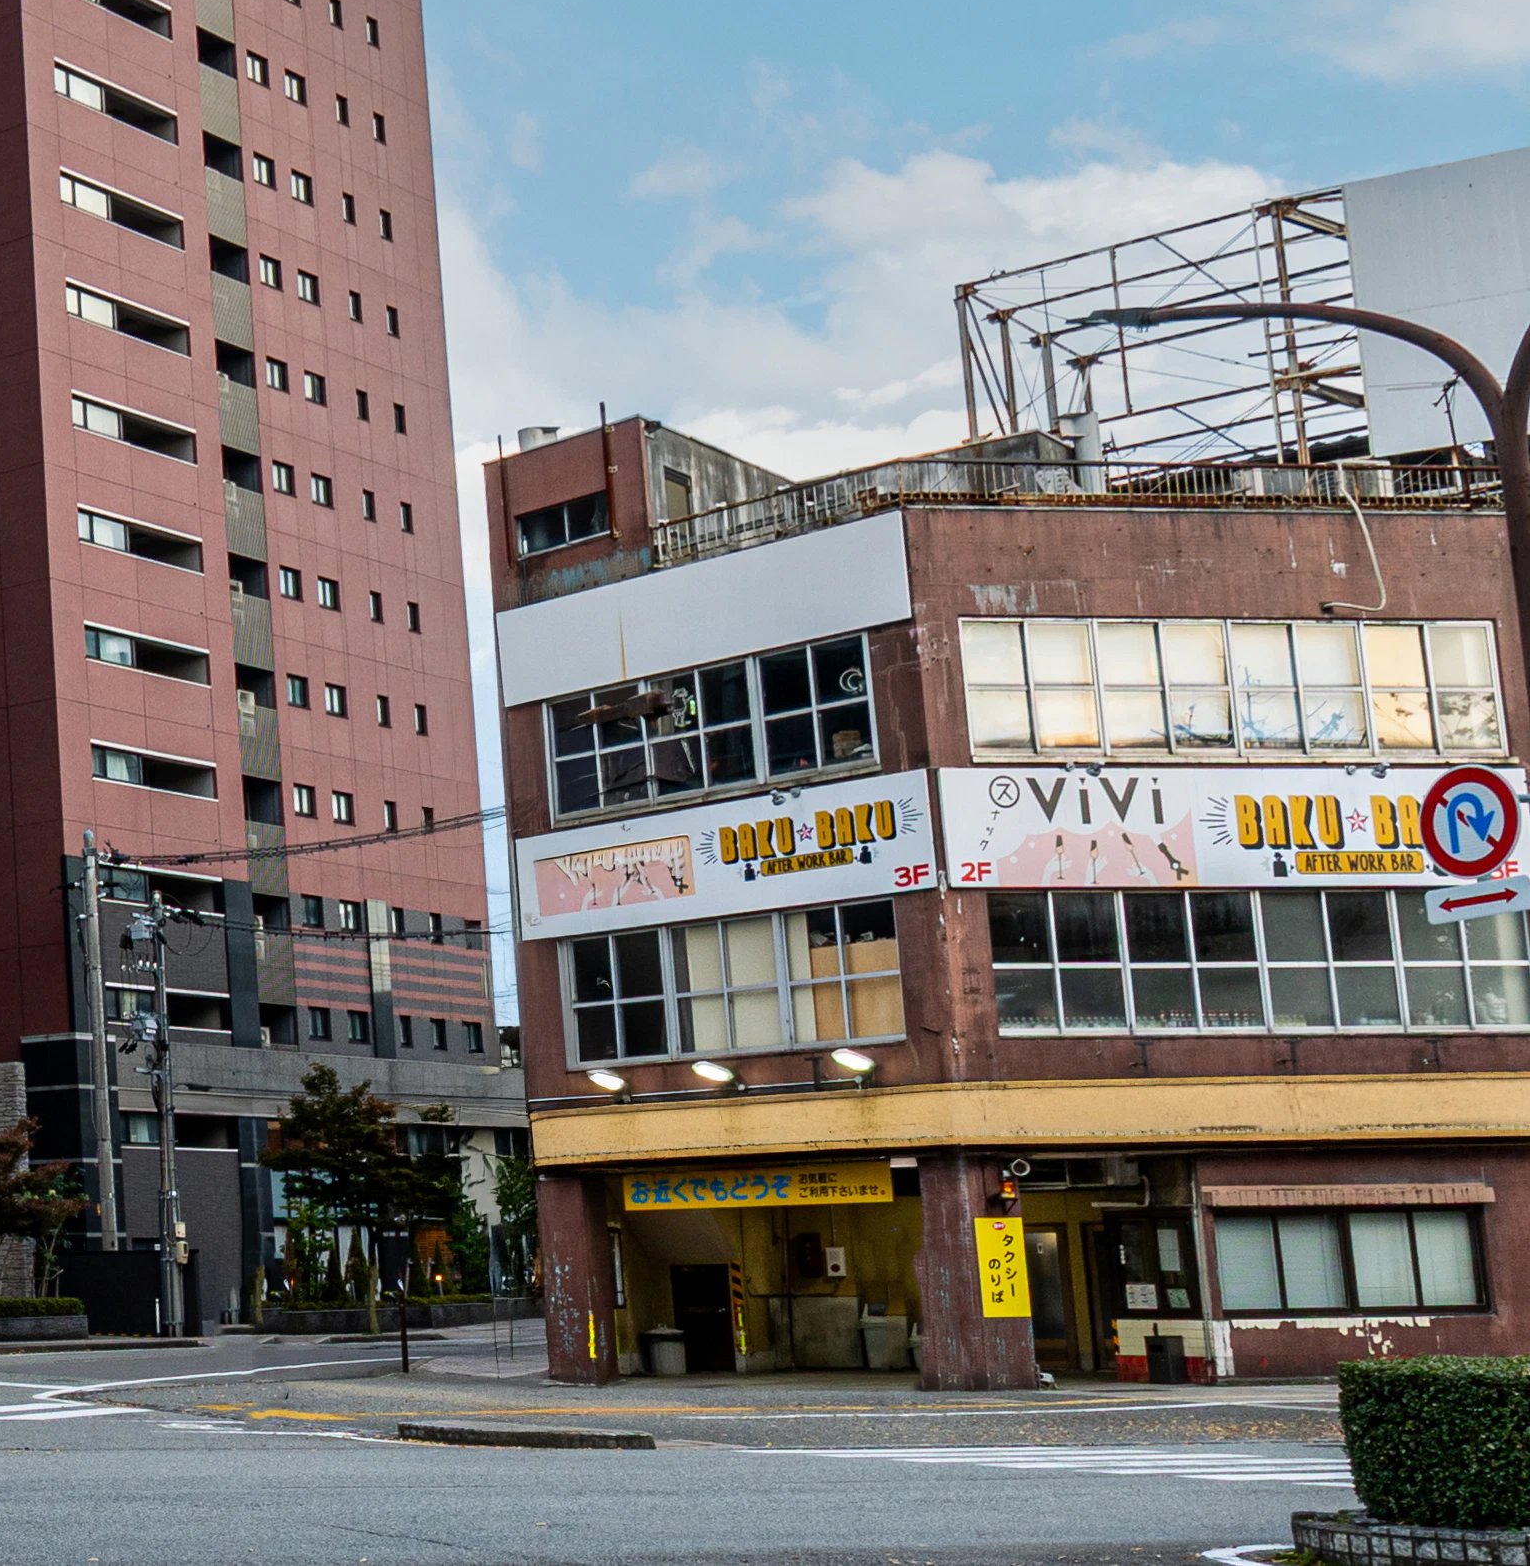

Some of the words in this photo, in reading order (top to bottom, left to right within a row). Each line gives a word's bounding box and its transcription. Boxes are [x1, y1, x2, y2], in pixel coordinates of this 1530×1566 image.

[719, 817, 797, 865] BAKU
[814, 800, 898, 850] BAKU
[1235, 795, 1345, 850] BAKU
[1370, 795, 1424, 850] BA
[766, 858, 794, 874] AFTER
[796, 853, 826, 870] WORK
[828, 850, 848, 865] BAR
[894, 863, 930, 888] 3F
[961, 862, 992, 882] 2F
[1305, 853, 1342, 872] AFTER
[1346, 853, 1385, 872] WORK
[1391, 853, 1417, 871] BAR
[630, 1174, 792, 1204] お近くでもどうぞ
[1003, 1234, 1018, 1297] タクシー
[988, 1258, 1004, 1304] のりば
